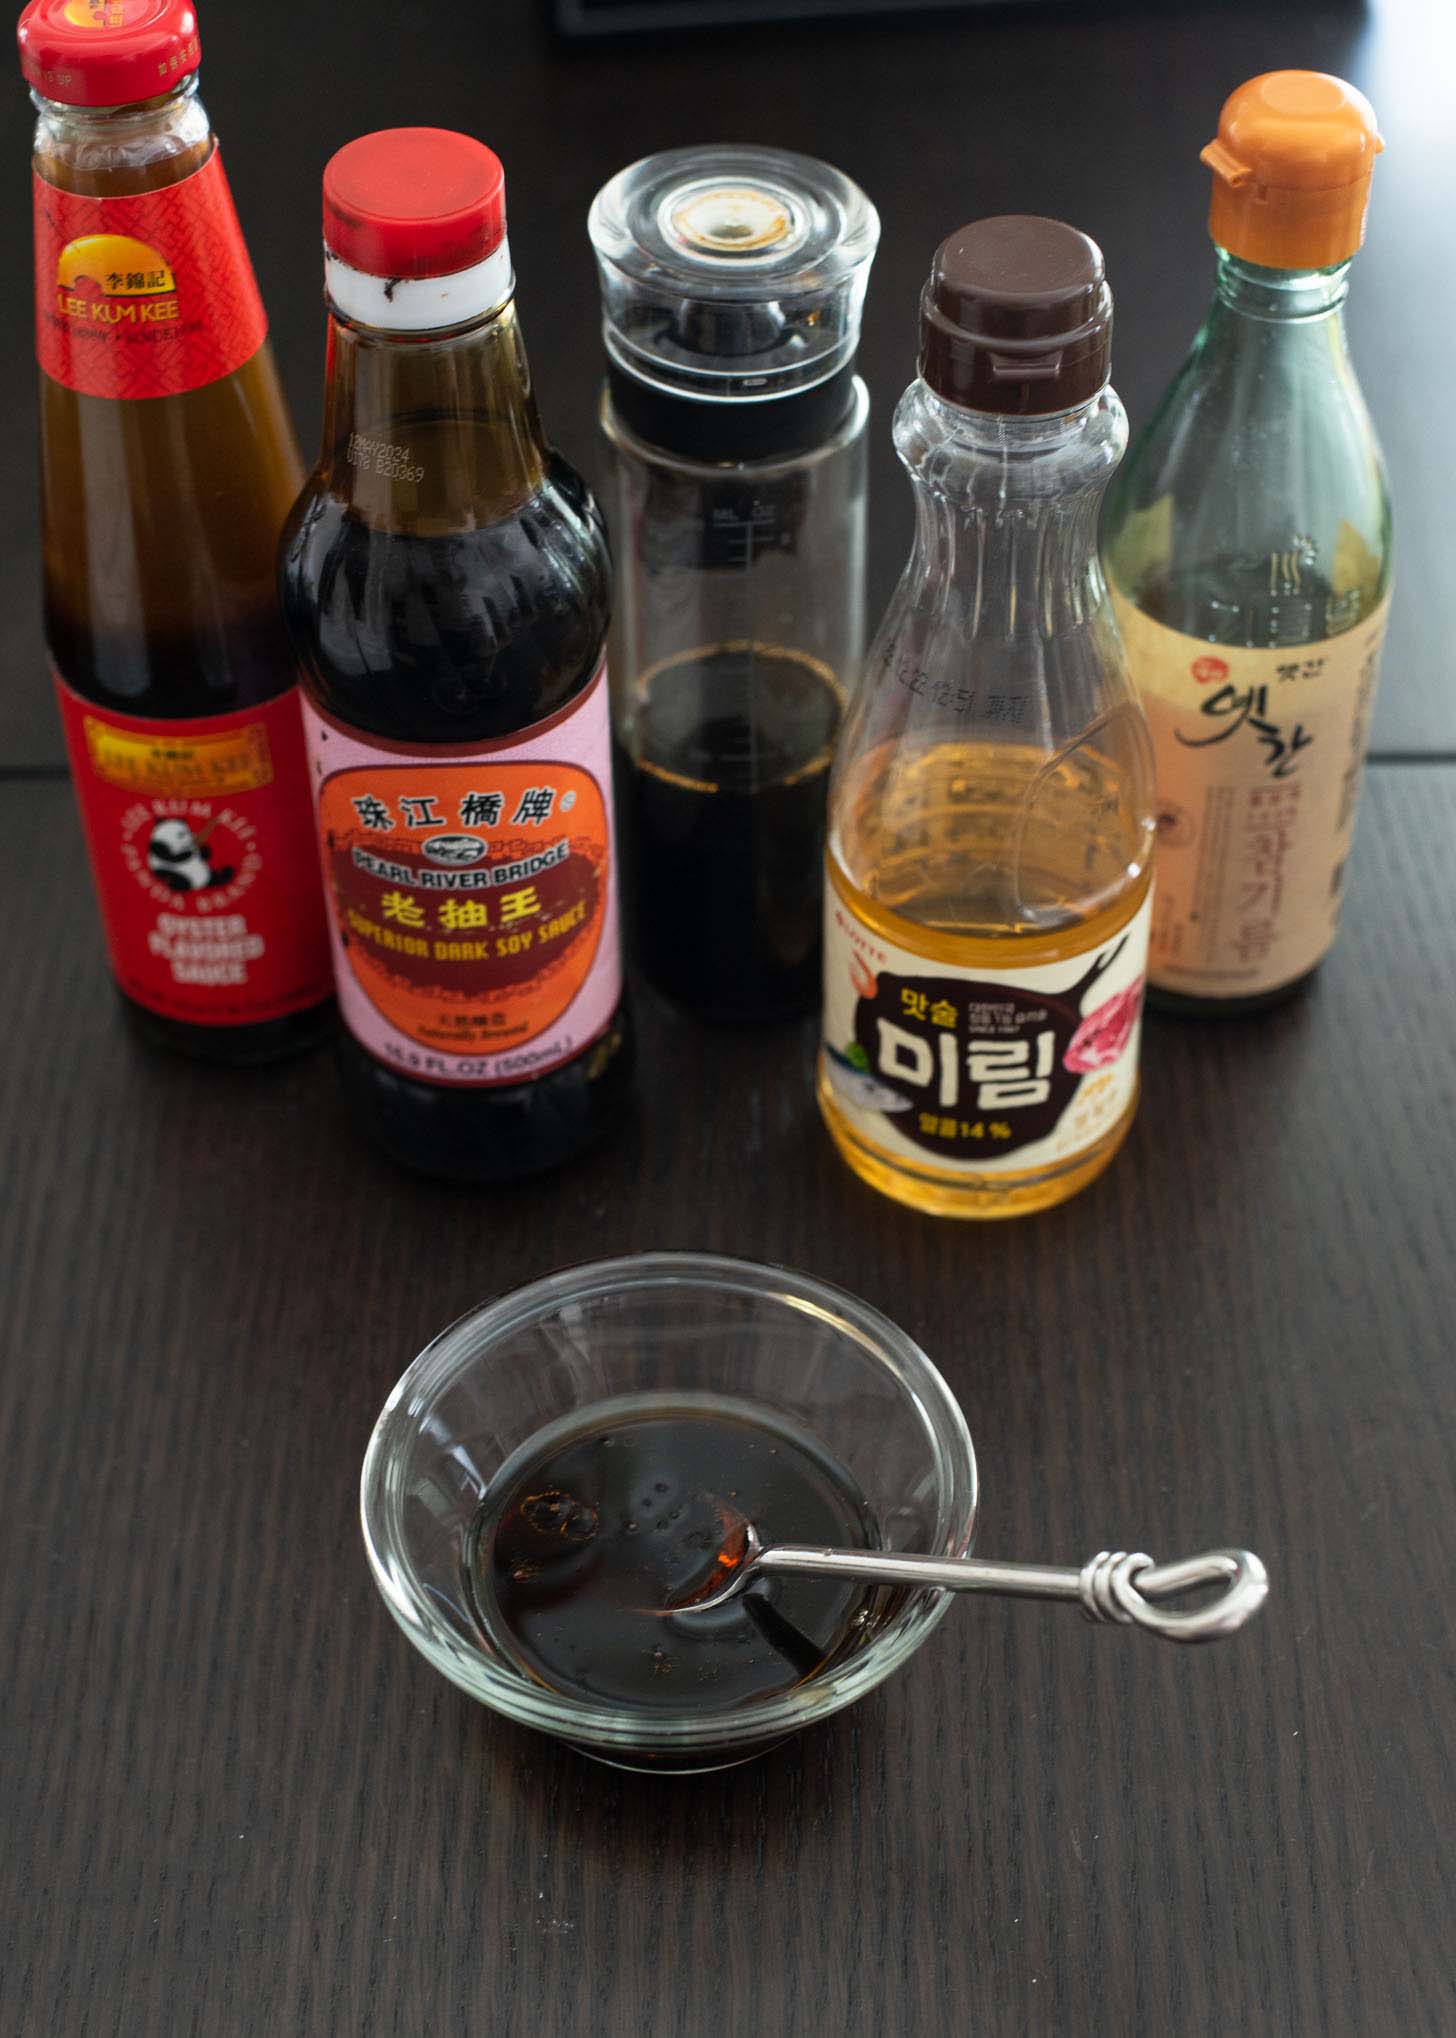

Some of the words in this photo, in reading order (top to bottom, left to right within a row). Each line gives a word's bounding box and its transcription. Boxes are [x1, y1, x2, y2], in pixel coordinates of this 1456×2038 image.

[105, 270, 165, 292] 李錦記
[57, 293, 89, 320] LEE
[91, 302, 137, 324] KUM
[140, 300, 179, 323] KEE
[352, 785, 555, 832] 珠江橋牌
[352, 846, 415, 885] PEARL
[420, 870, 488, 889] RIVER
[493, 839, 570, 883] BRIDGE
[380, 885, 541, 928] 老抽王
[347, 909, 430, 957] SUPERIOR
[432, 939, 489, 962] DARK
[495, 932, 534, 957] SOY
[537, 899, 588, 944] SAUCE
[901, 987, 958, 1030] 맛술
[877, 1016, 1055, 1110] 미림
